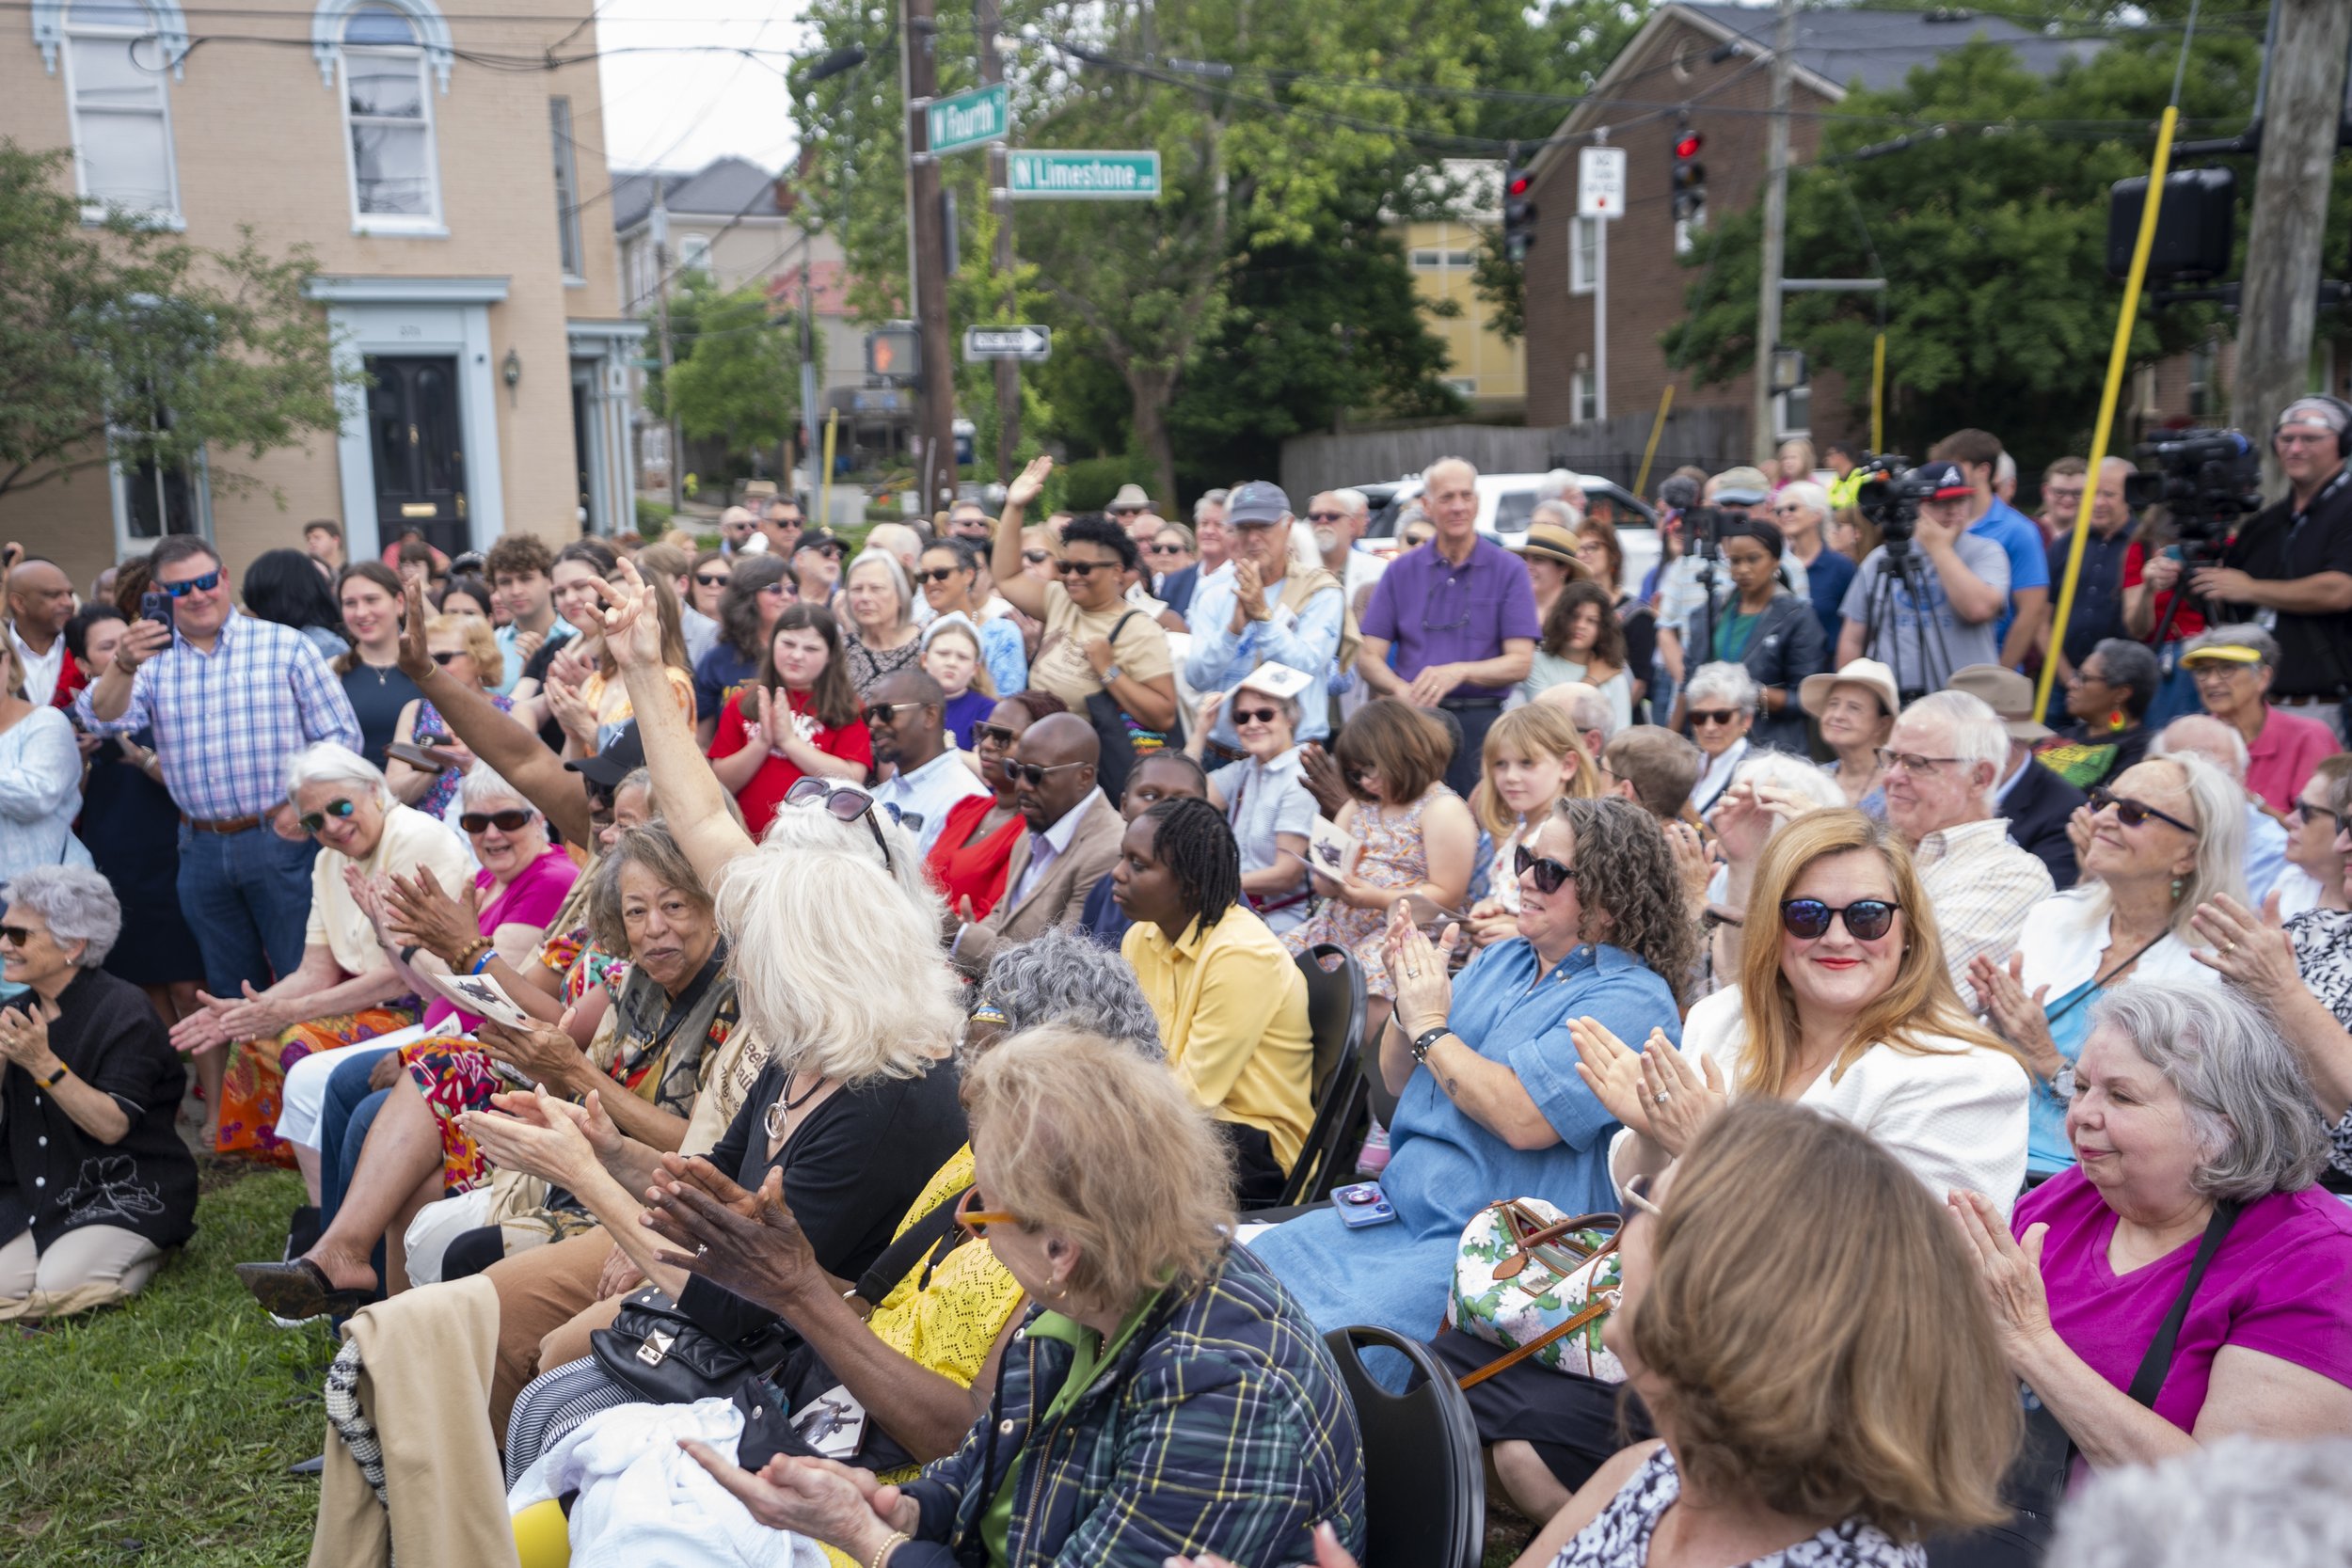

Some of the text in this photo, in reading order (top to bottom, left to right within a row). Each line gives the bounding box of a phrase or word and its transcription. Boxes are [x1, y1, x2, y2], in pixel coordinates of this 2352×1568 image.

[946, 98, 995, 141] Fourth
[1015, 158, 1032, 188] N
[1034, 158, 1136, 189] Limestone
